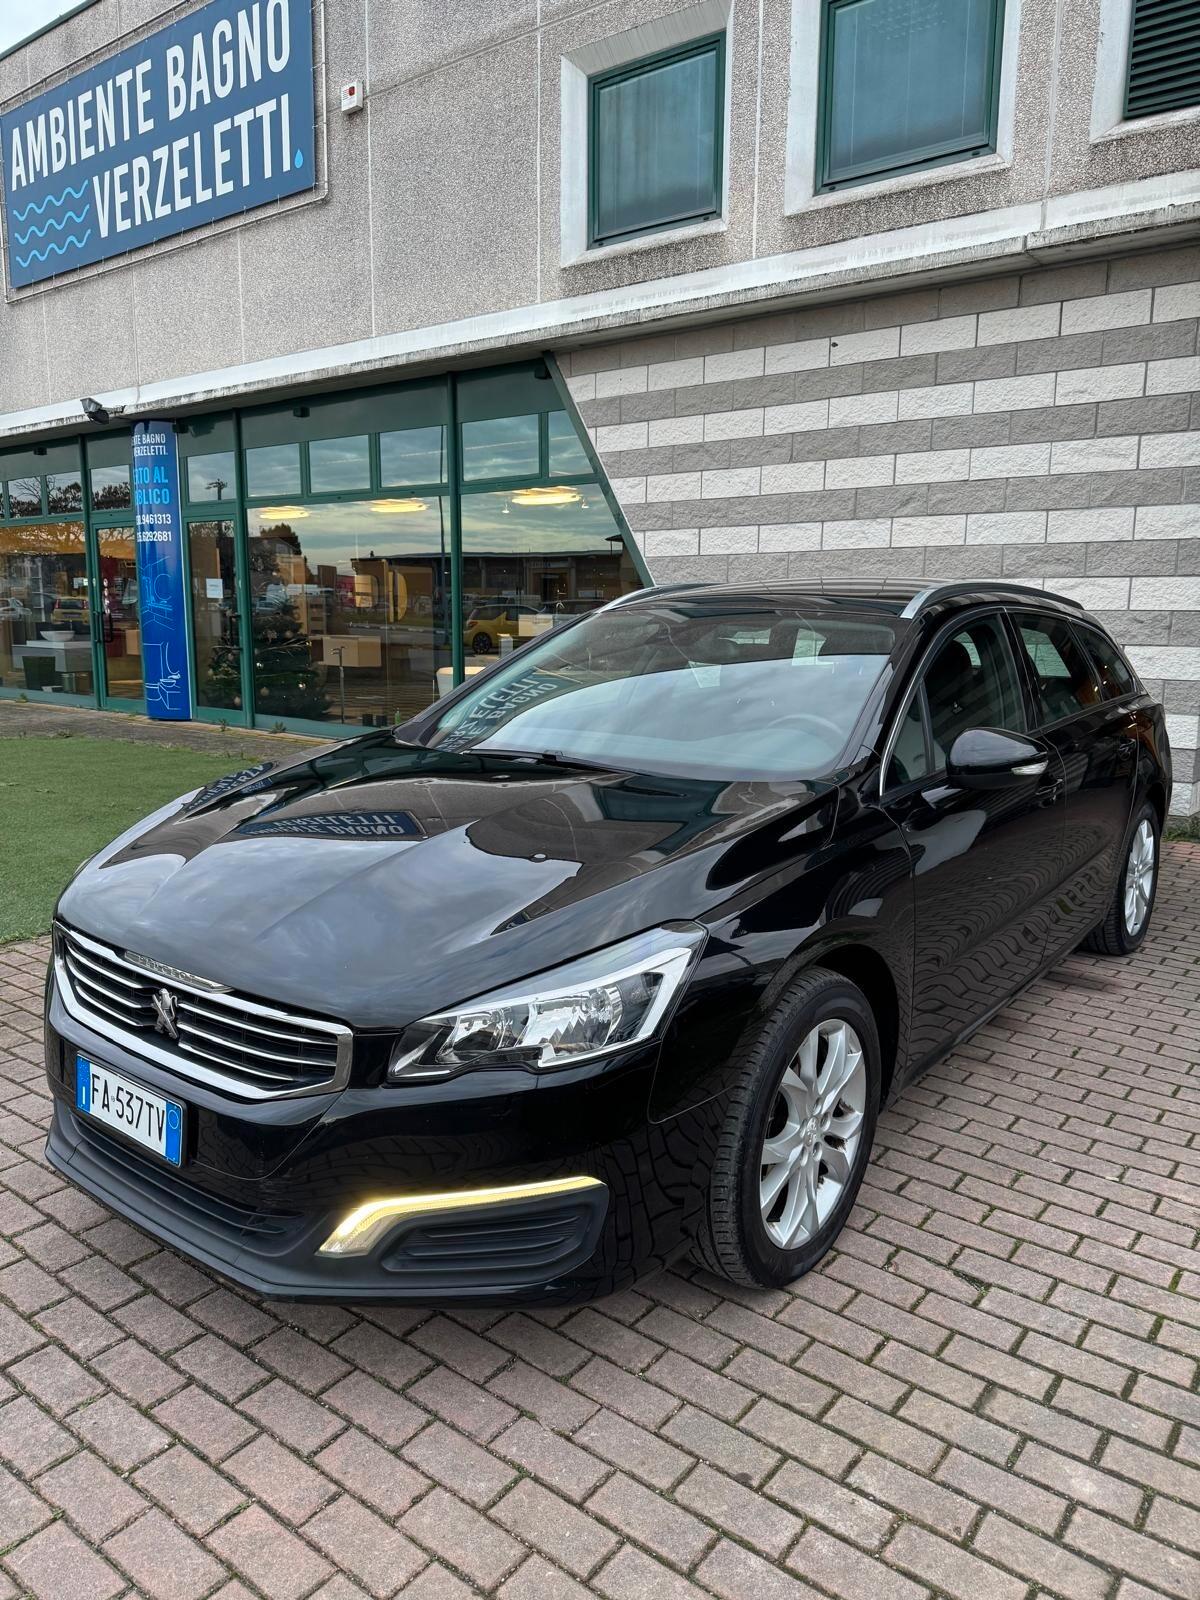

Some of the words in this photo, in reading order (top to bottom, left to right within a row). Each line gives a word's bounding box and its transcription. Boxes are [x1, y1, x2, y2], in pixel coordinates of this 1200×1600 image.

[11, 58, 154, 192] AMBIENTE
[166, 0, 291, 121] BAGNO
[142, 433, 166, 444] BAGNO
[153, 465, 169, 483] AL
